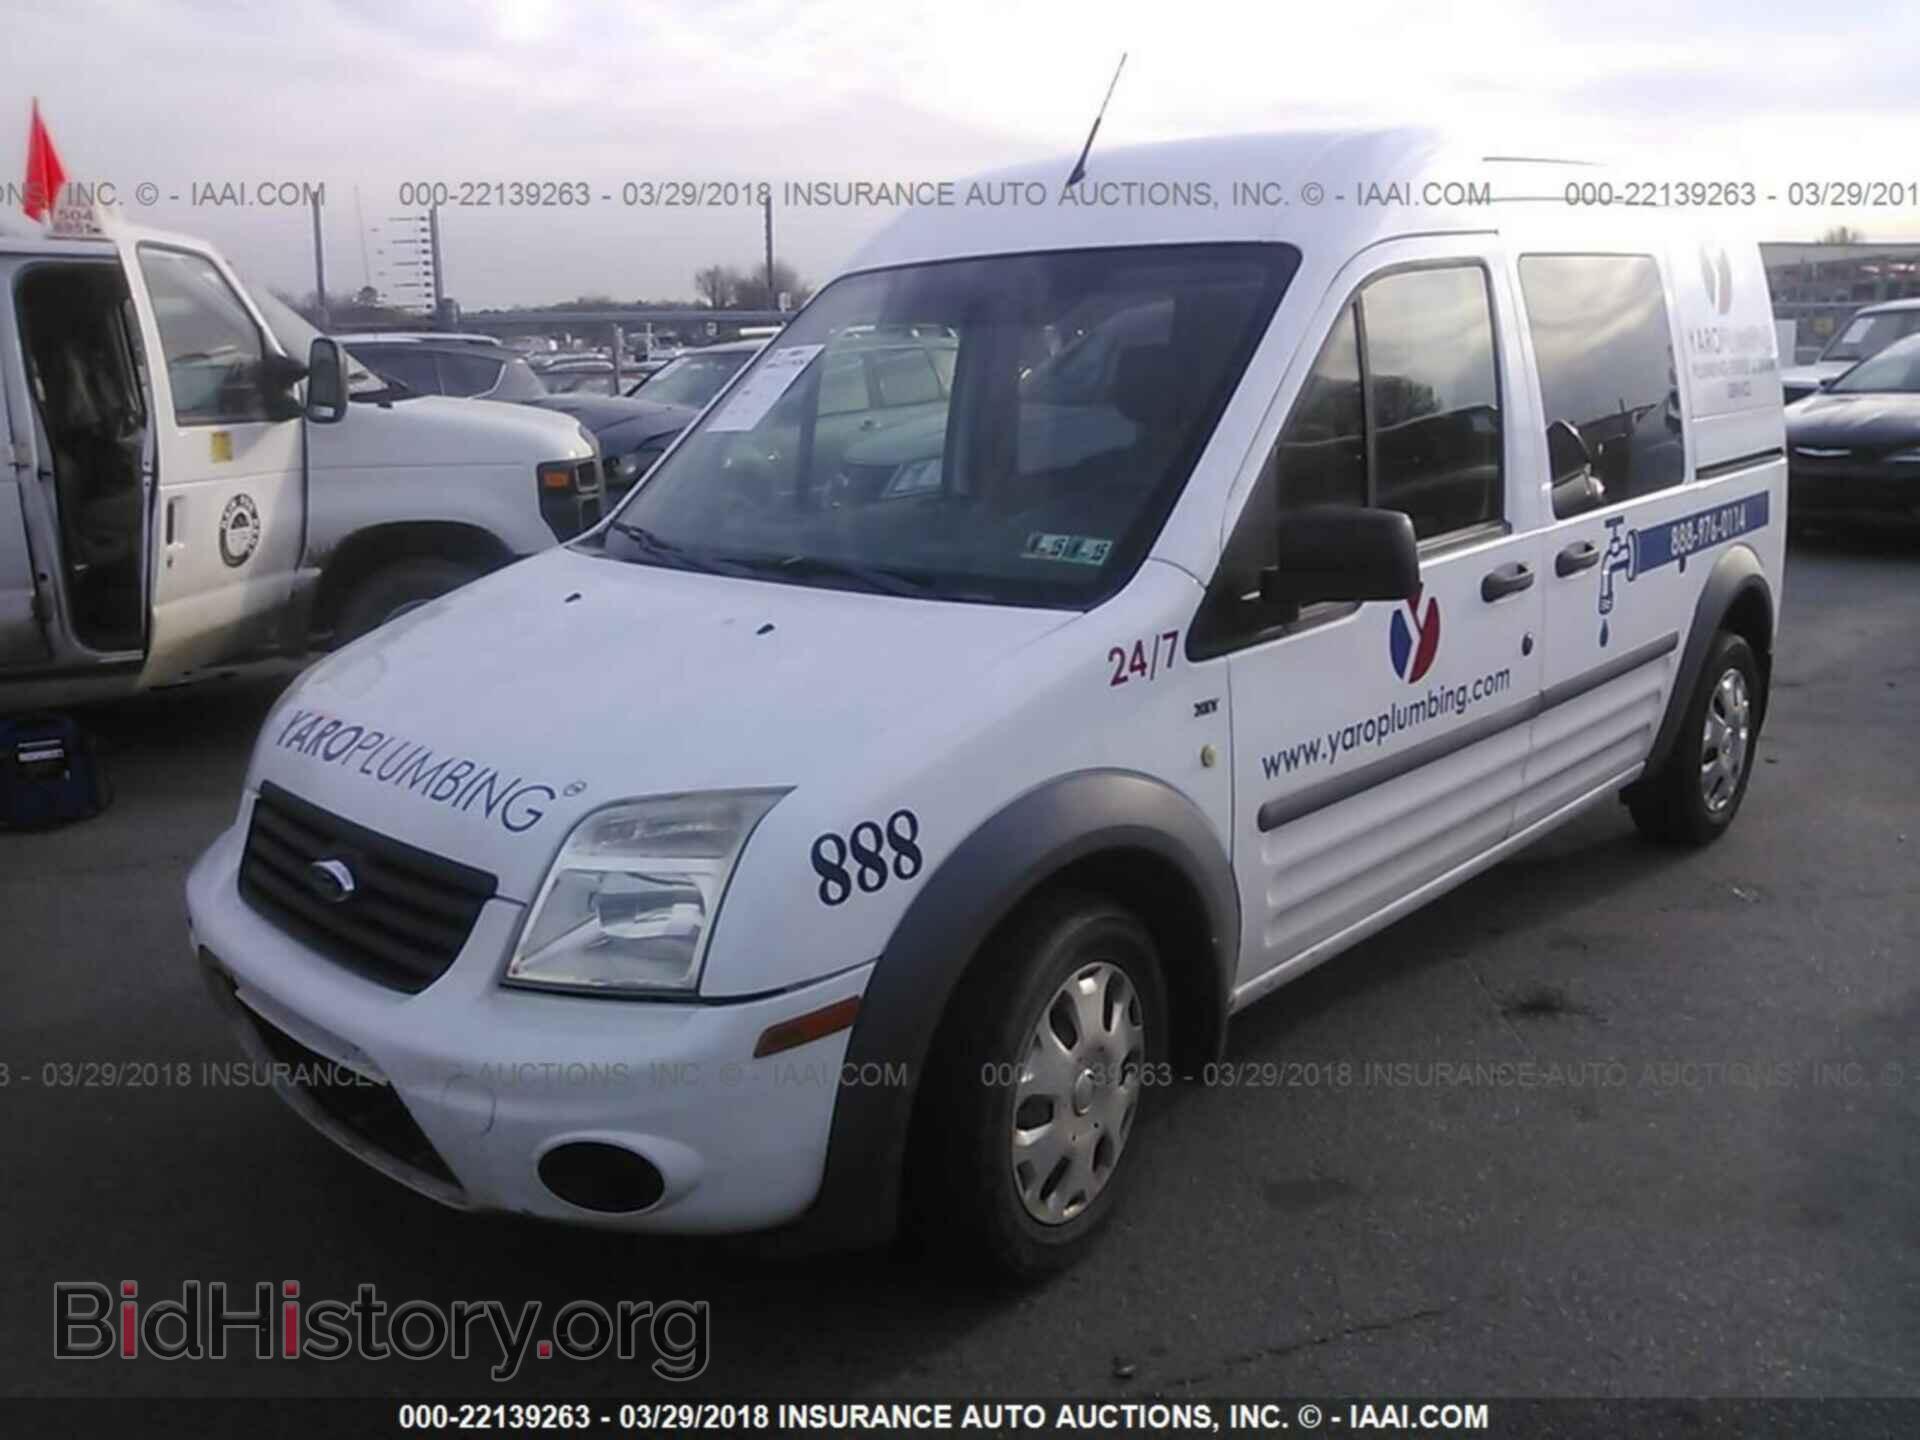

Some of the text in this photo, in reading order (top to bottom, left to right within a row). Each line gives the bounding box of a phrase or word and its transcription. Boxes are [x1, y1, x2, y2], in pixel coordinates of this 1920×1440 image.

[1108, 629, 1179, 687] 24/7
[276, 709, 556, 832] YAROPLUMBING
[1262, 668, 1511, 780] www.yaroplumbing.com
[811, 809, 922, 906] 888
